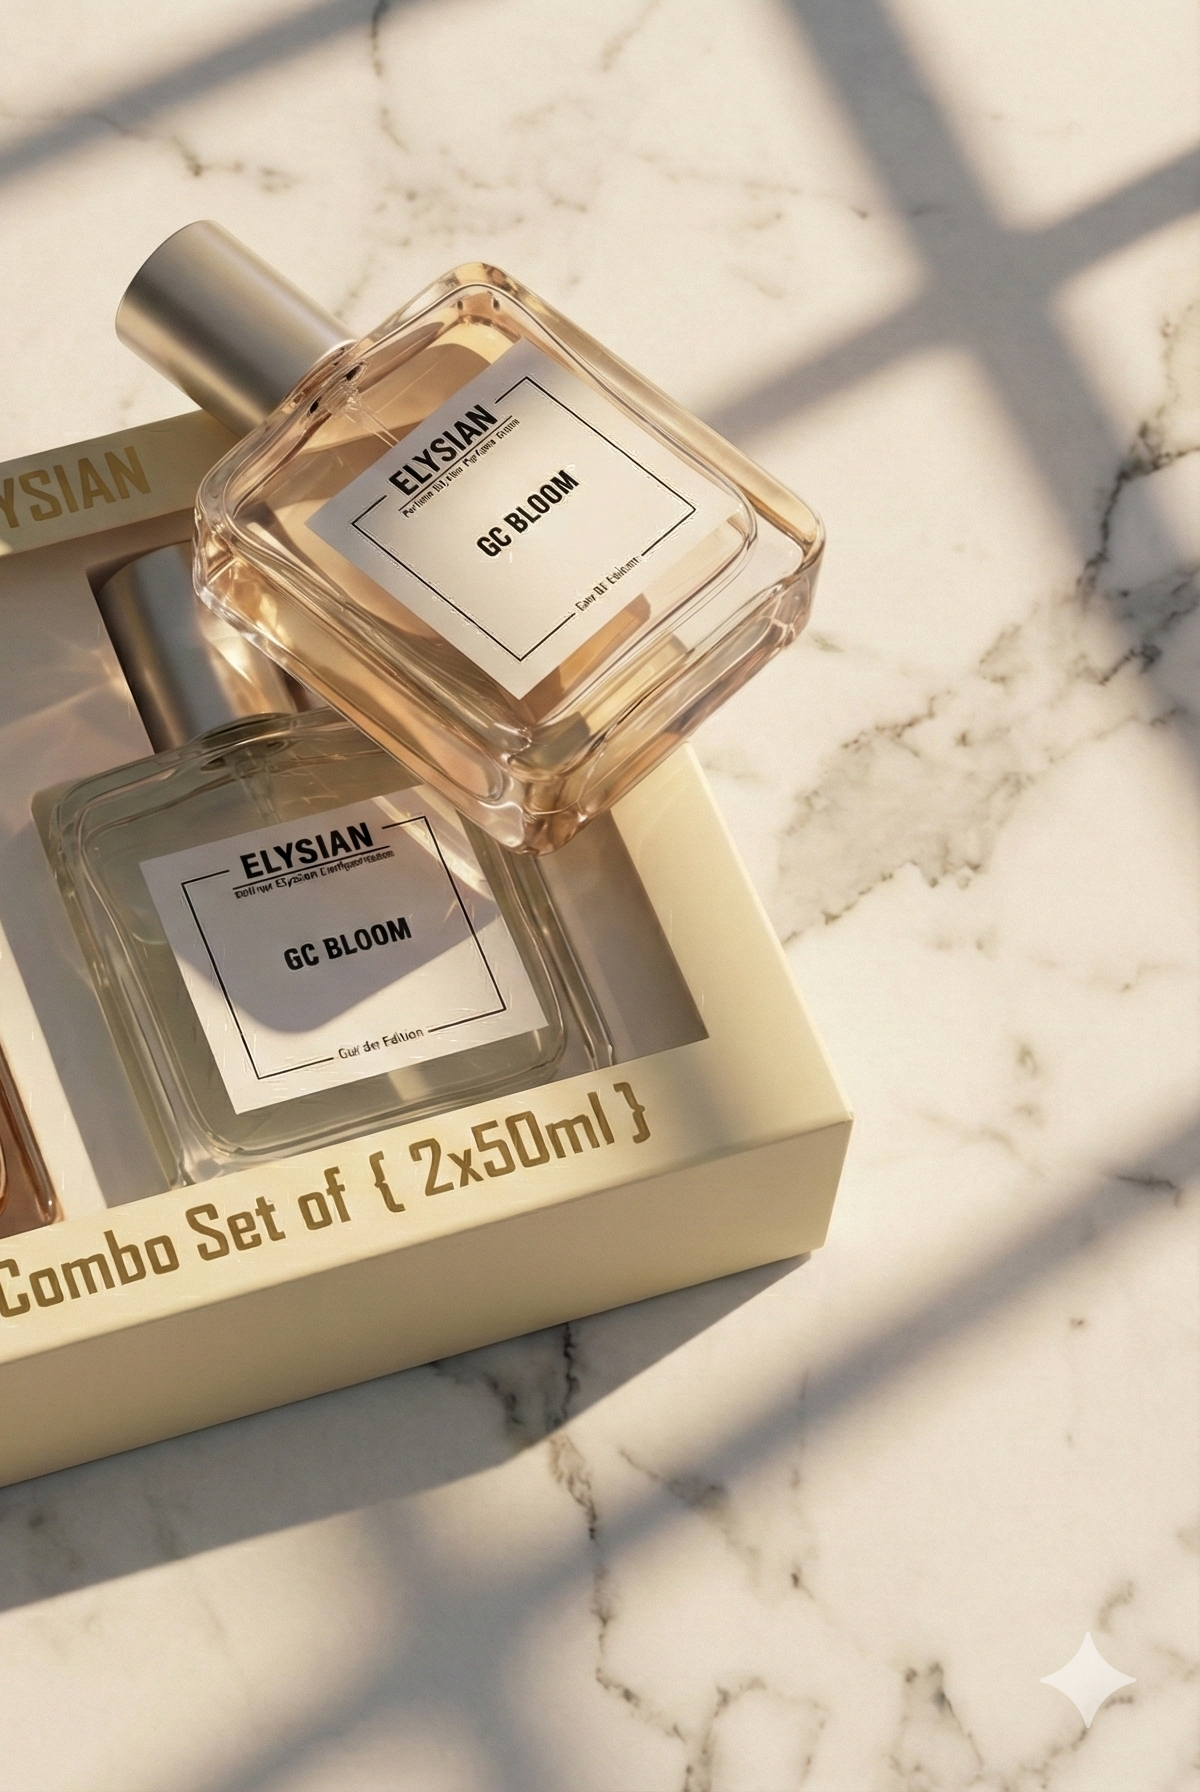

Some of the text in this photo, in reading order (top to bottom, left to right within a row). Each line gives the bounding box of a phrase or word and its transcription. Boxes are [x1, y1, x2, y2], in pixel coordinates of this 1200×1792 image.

[388, 404, 498, 496] ELYSIAN
[476, 469, 579, 557] GC BLOOM
[240, 822, 374, 879] ELYSIAN
[284, 917, 412, 970] GC BLOOM
[185, 1196, 285, 1262] Set
[297, 1166, 351, 1231] of
[368, 1150, 406, 1213] {
[408, 1091, 615, 1197] 2x50ml
[612, 1081, 652, 1144] }
